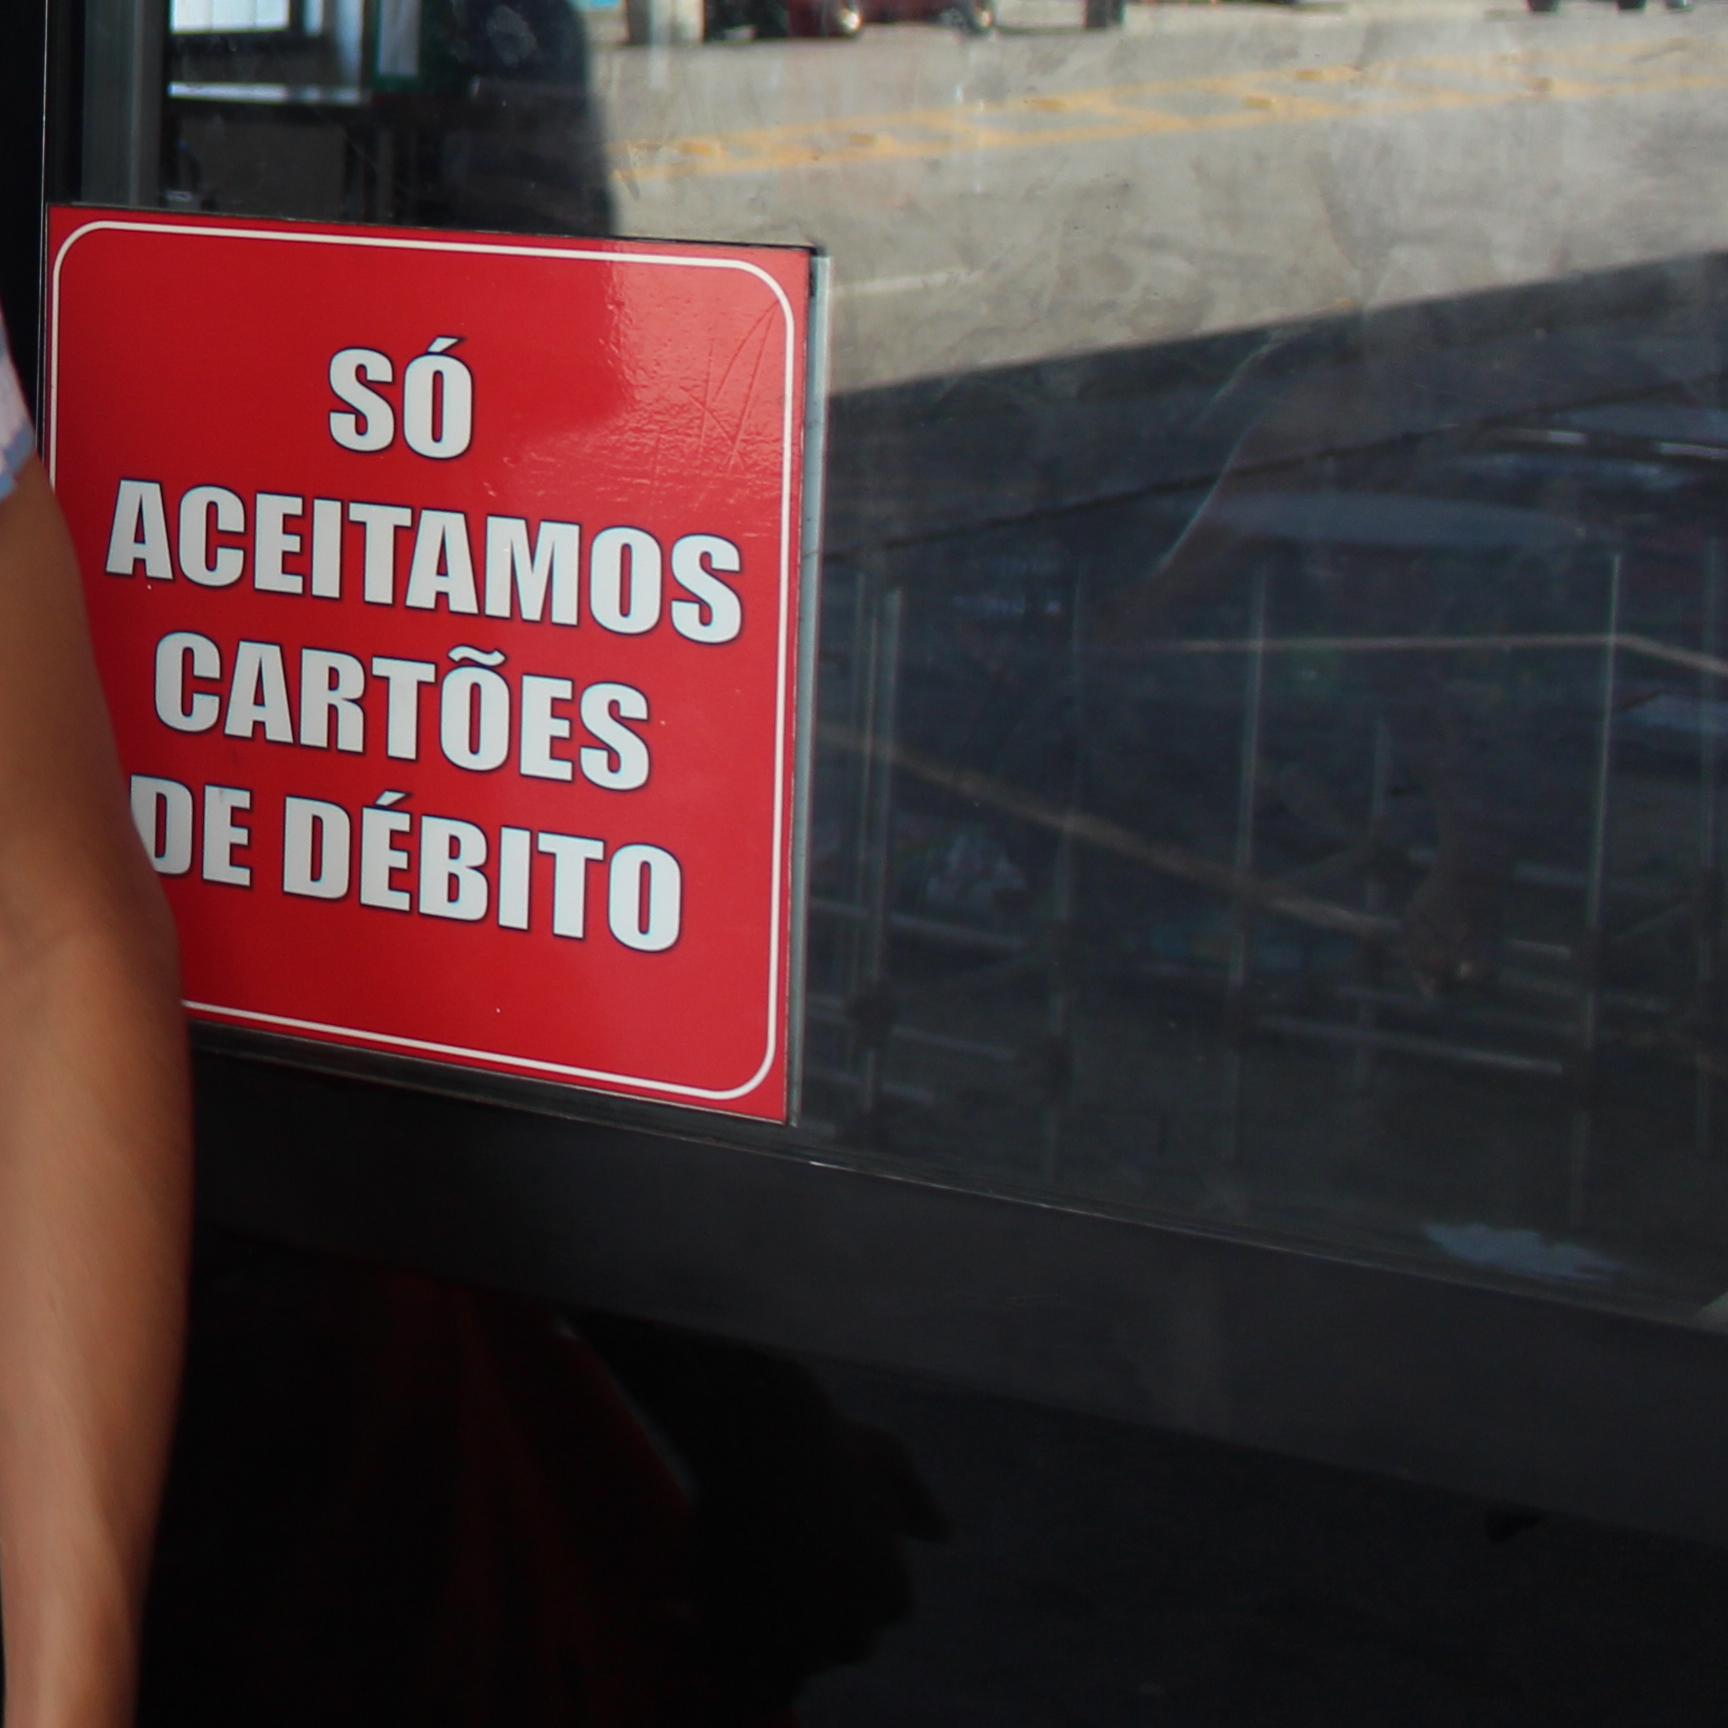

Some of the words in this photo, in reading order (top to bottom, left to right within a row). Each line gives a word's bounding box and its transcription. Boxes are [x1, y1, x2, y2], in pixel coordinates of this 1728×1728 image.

[328, 336, 473, 460] SÓ
[106, 479, 743, 645] ACEITAMOS
[154, 632, 650, 791] CARTÕES
[128, 773, 251, 887] DE
[283, 791, 682, 953] DÉBITO
